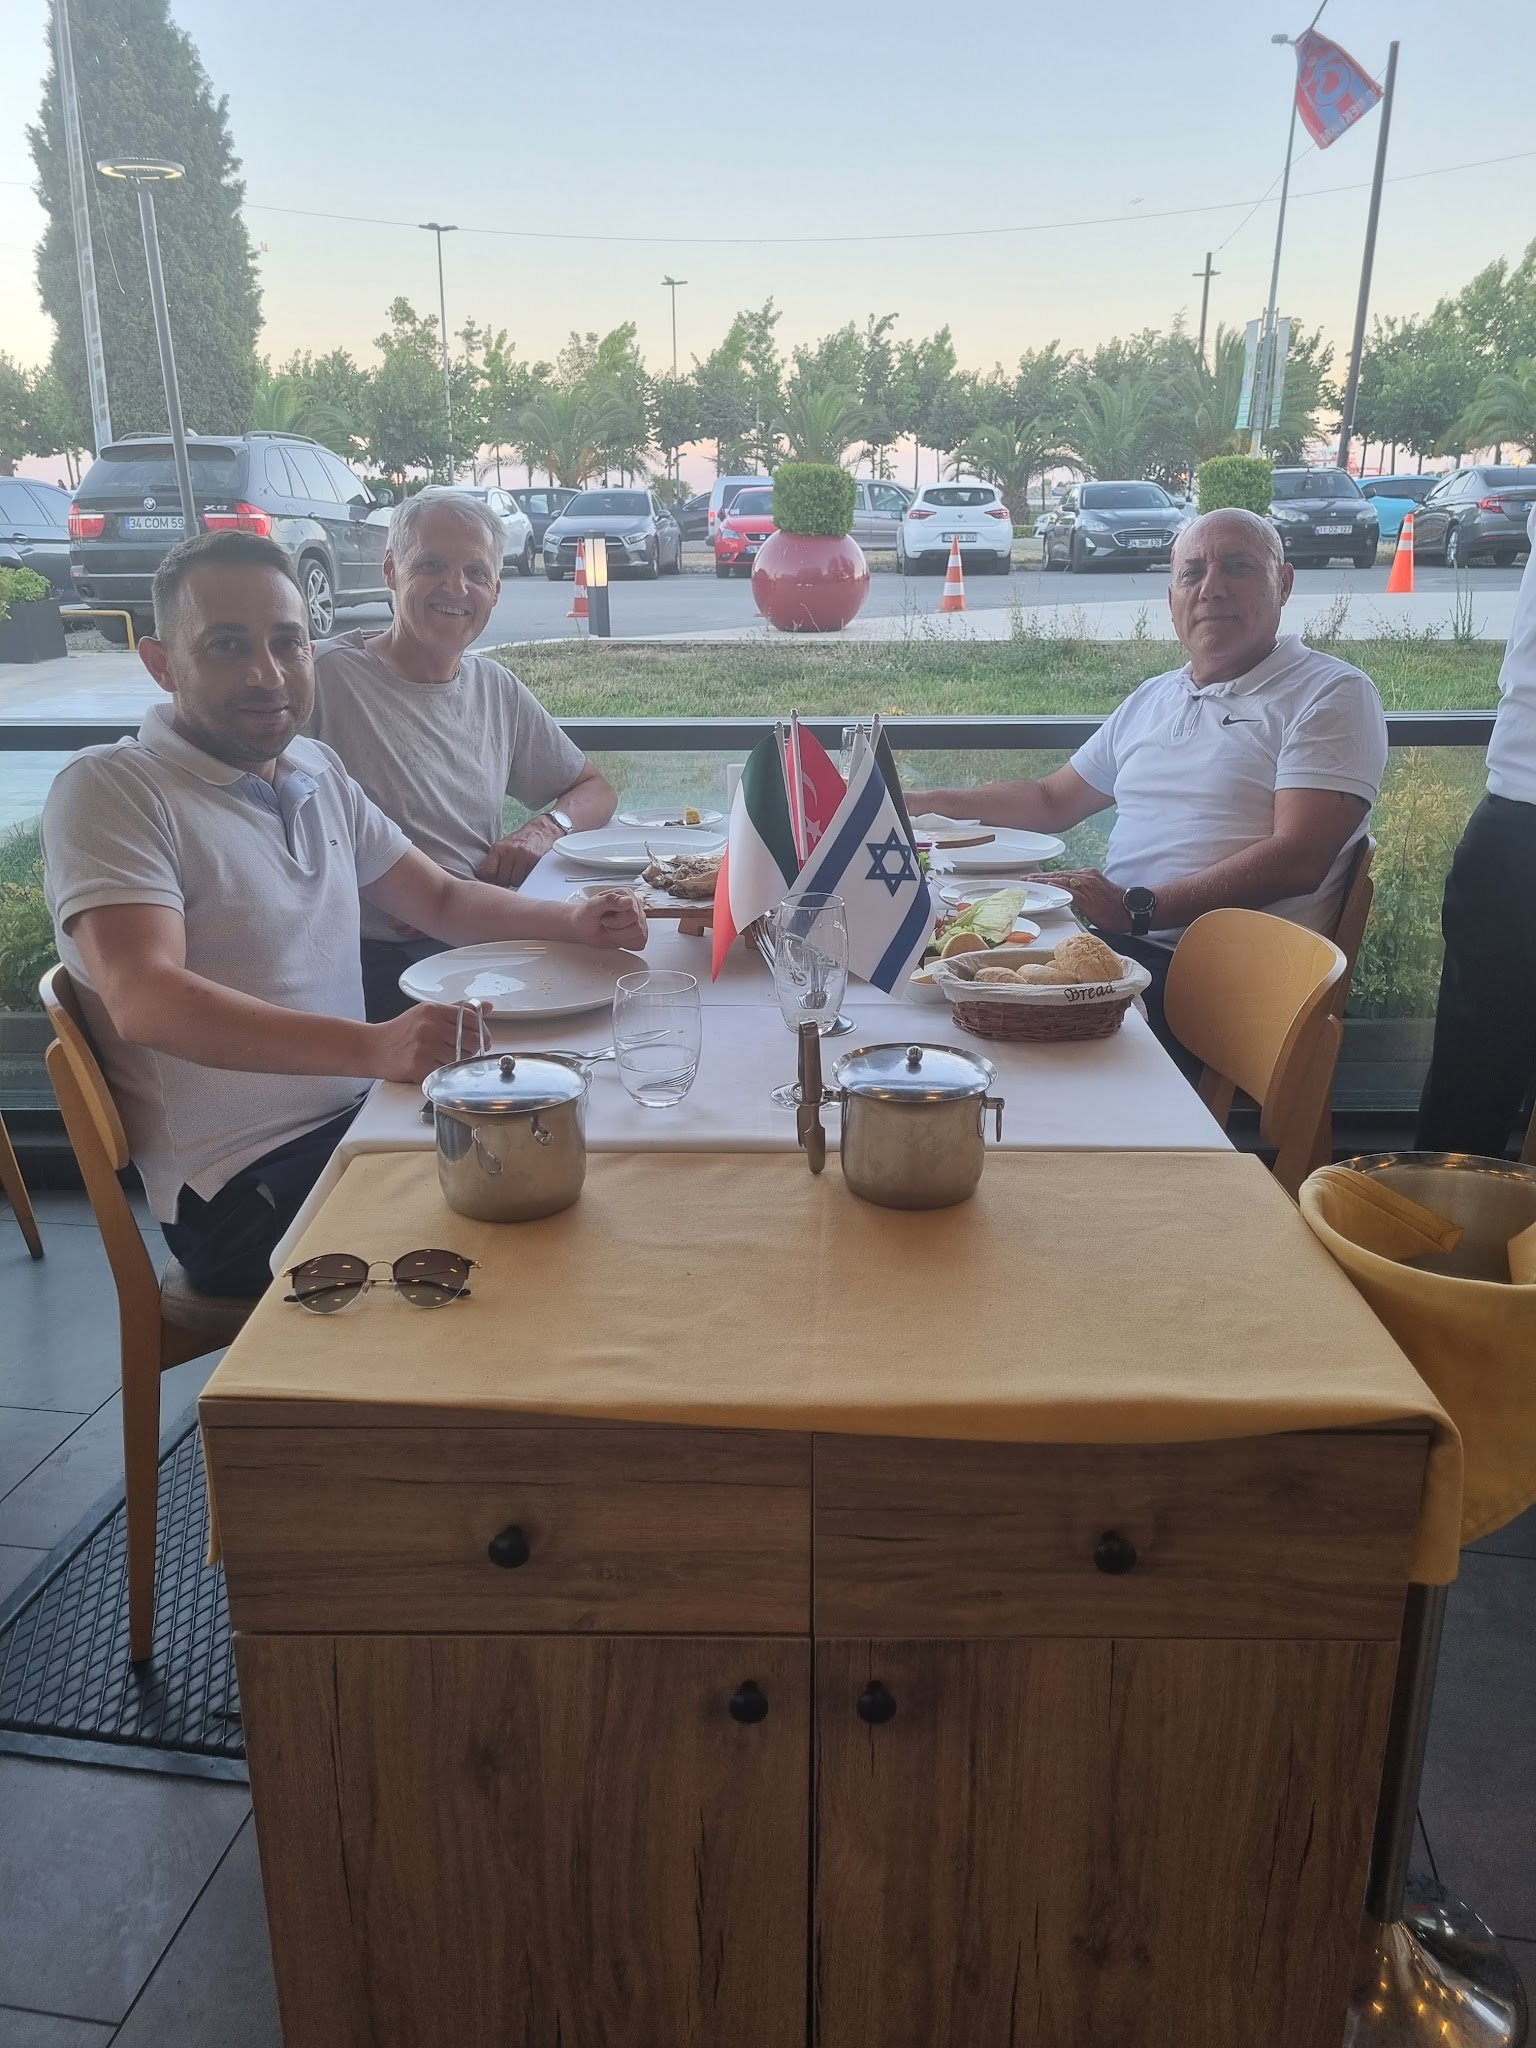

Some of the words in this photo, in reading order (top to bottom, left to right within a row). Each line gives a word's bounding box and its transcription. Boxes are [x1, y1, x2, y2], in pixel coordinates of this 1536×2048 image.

[130, 517, 142, 529] 34
[144, 517, 169, 529] COM
[1063, 980, 1117, 1002] Bread
